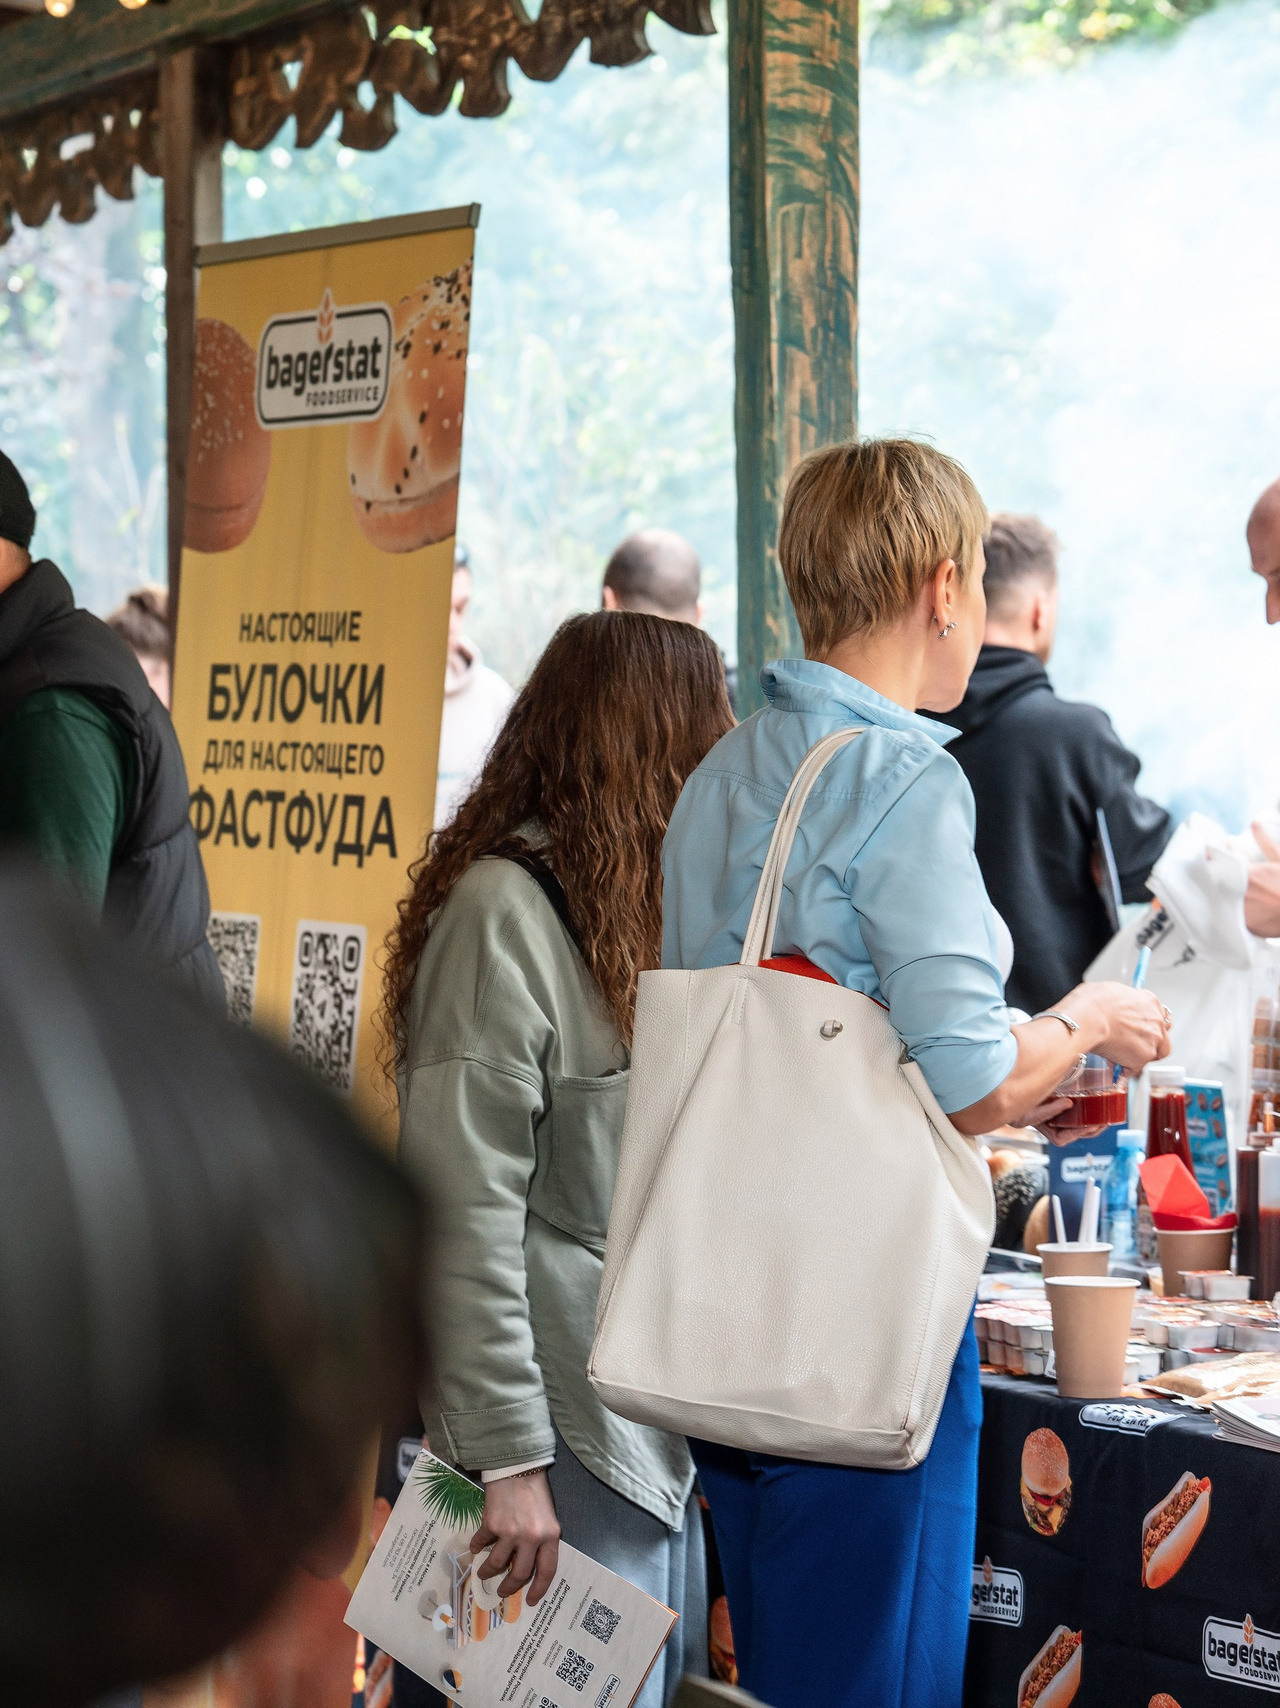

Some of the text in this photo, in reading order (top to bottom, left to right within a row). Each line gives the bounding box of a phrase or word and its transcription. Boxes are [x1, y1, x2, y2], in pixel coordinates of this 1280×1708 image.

[266, 337, 382, 397] bagerstat
[305, 386, 379, 407] FOODSERVICE
[239, 611, 362, 647] НАСТОЯЩИЕ
[207, 662, 385, 725] БУЛОЧКИ
[203, 739, 385, 779] ДЛЯ НАСТОЯЩЕГО
[188, 784, 398, 868] ФАСТФУДА
[972, 1582, 1019, 1607] gerstat
[535, 1633, 545, 1647] всей
[518, 1647, 536, 1680] территории
